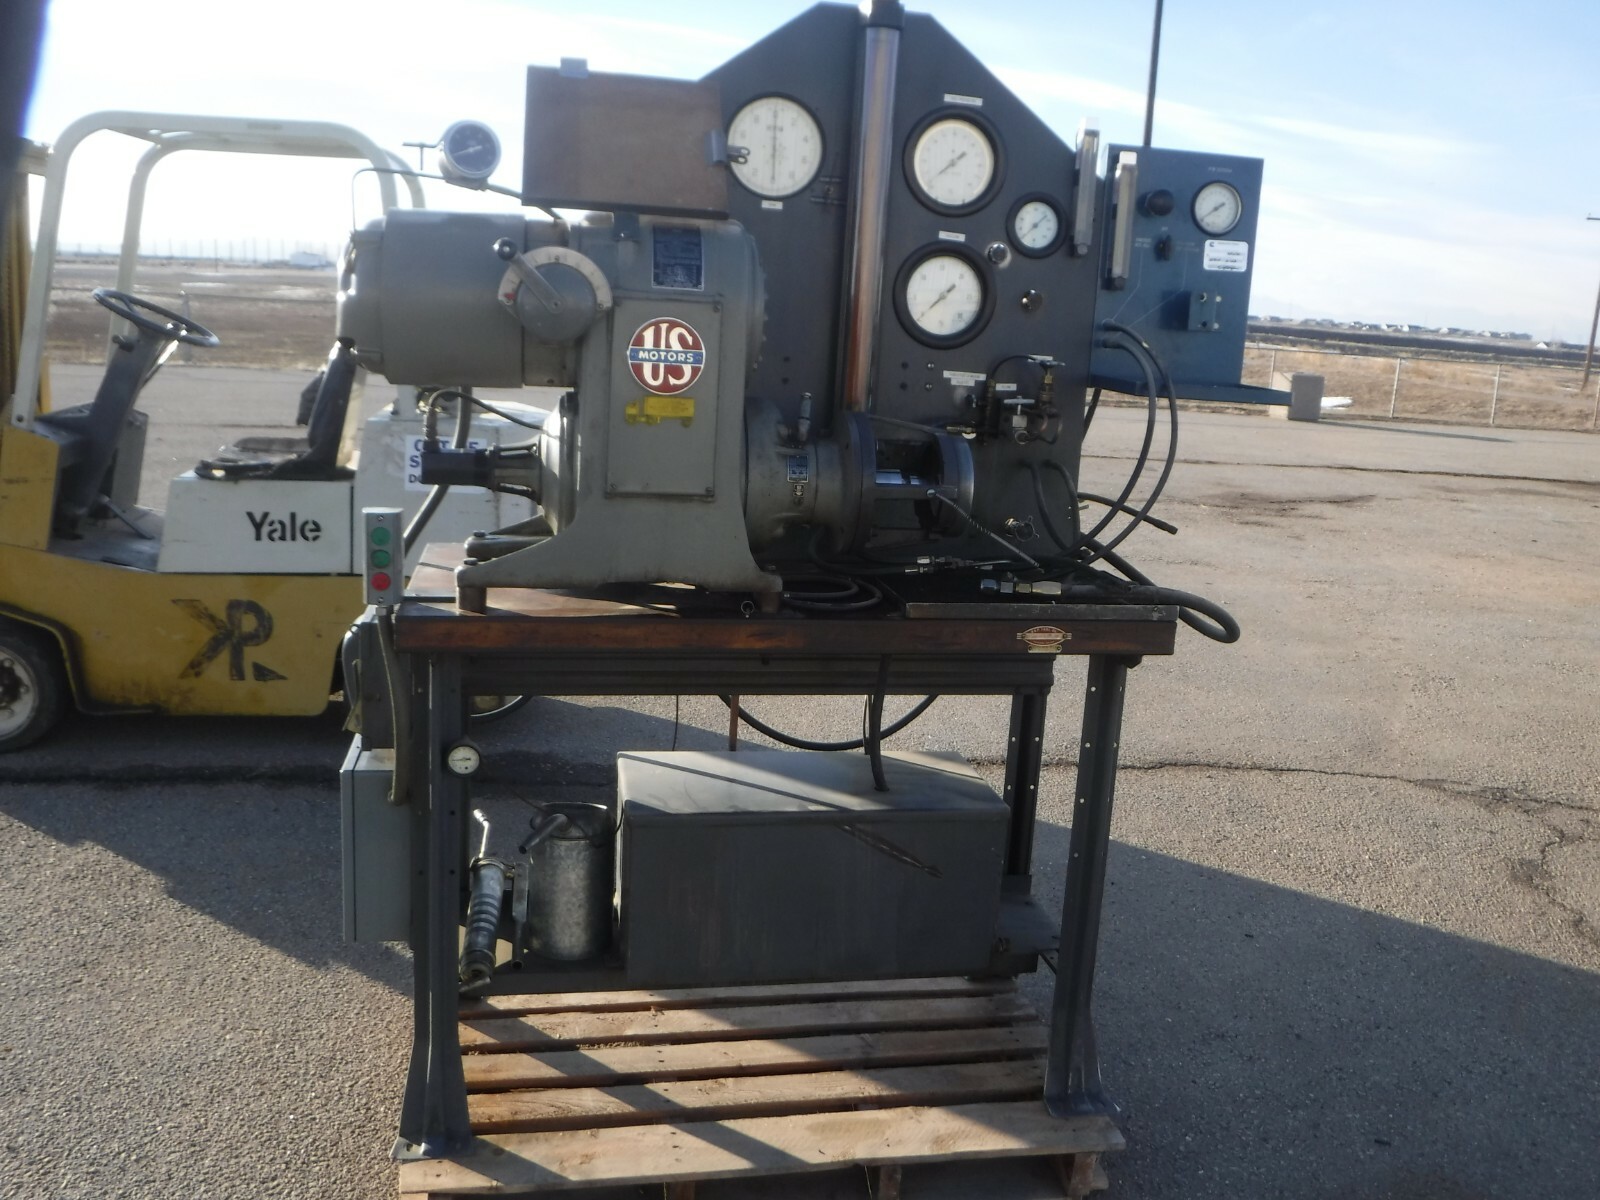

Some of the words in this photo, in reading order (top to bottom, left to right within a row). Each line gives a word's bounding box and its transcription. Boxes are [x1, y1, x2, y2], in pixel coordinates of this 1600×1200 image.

[638, 350, 694, 362] MOTORS
[642, 323, 693, 386] US
[245, 511, 322, 542] Yale
